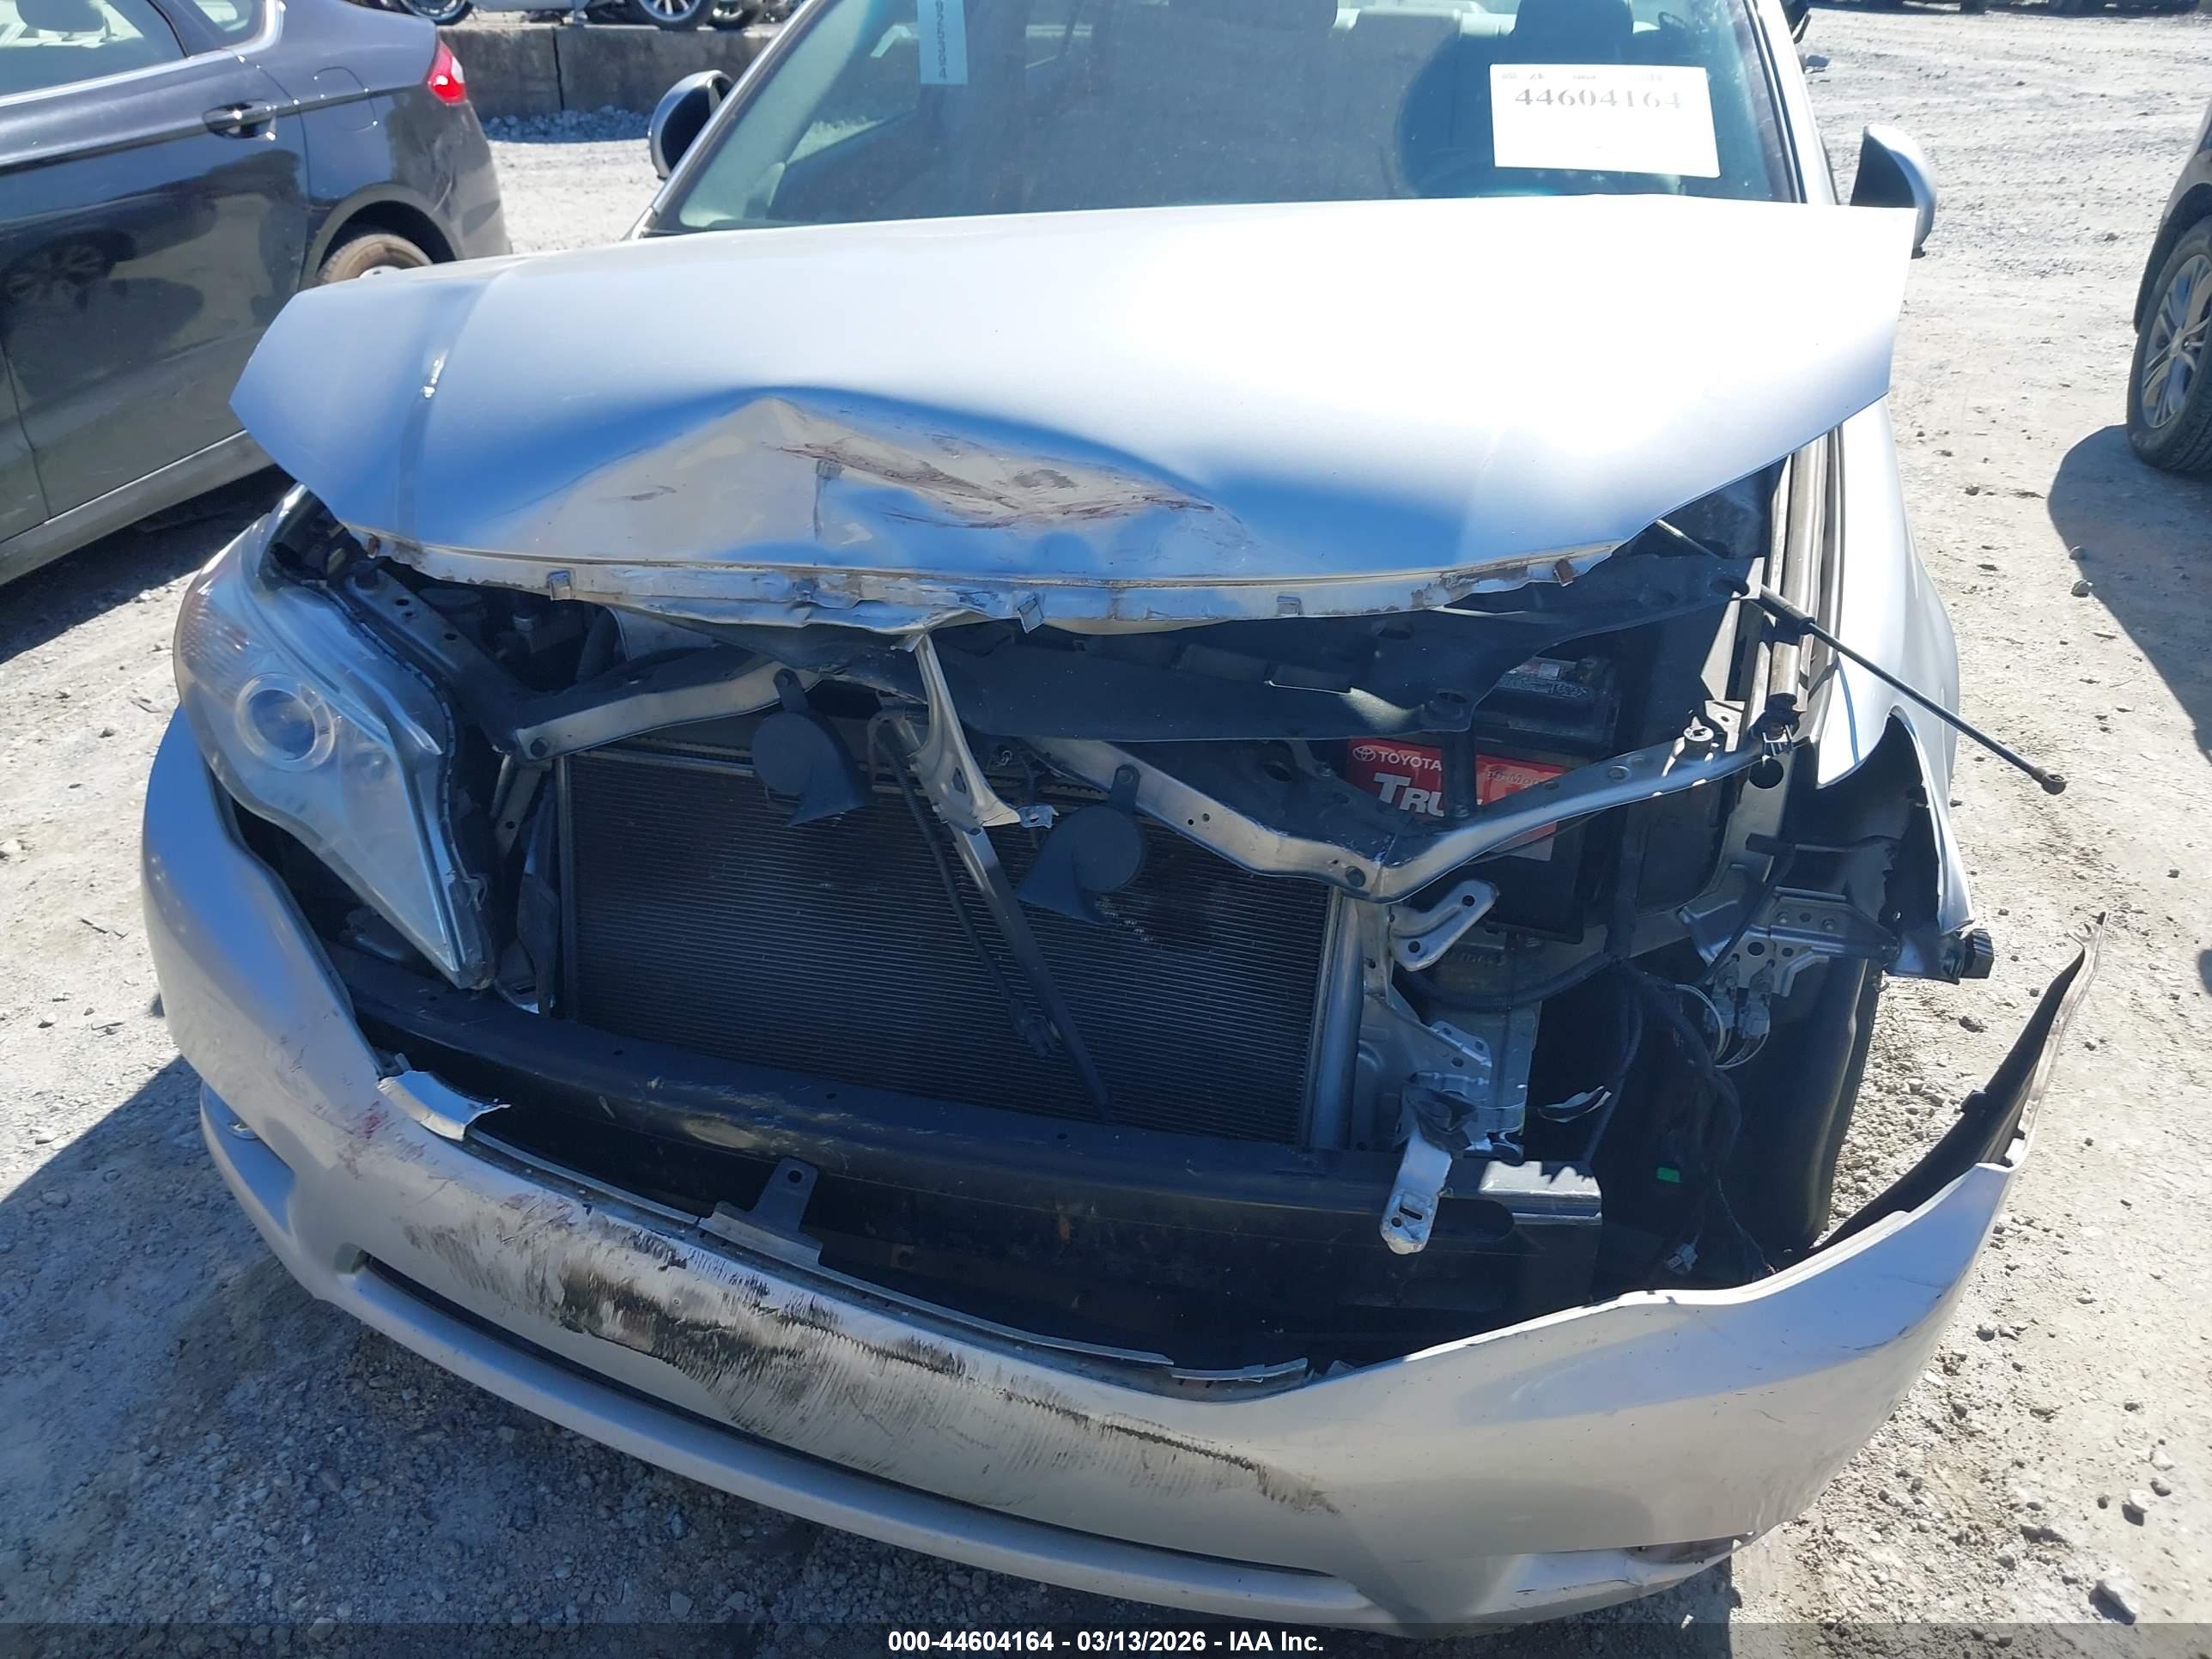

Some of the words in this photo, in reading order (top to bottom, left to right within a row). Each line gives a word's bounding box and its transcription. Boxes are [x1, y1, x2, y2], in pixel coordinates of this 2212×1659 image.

[1515, 88, 1680, 109] 44604164
[1378, 751, 1443, 771] TOYOTA
[1374, 773, 1483, 817] TRU
